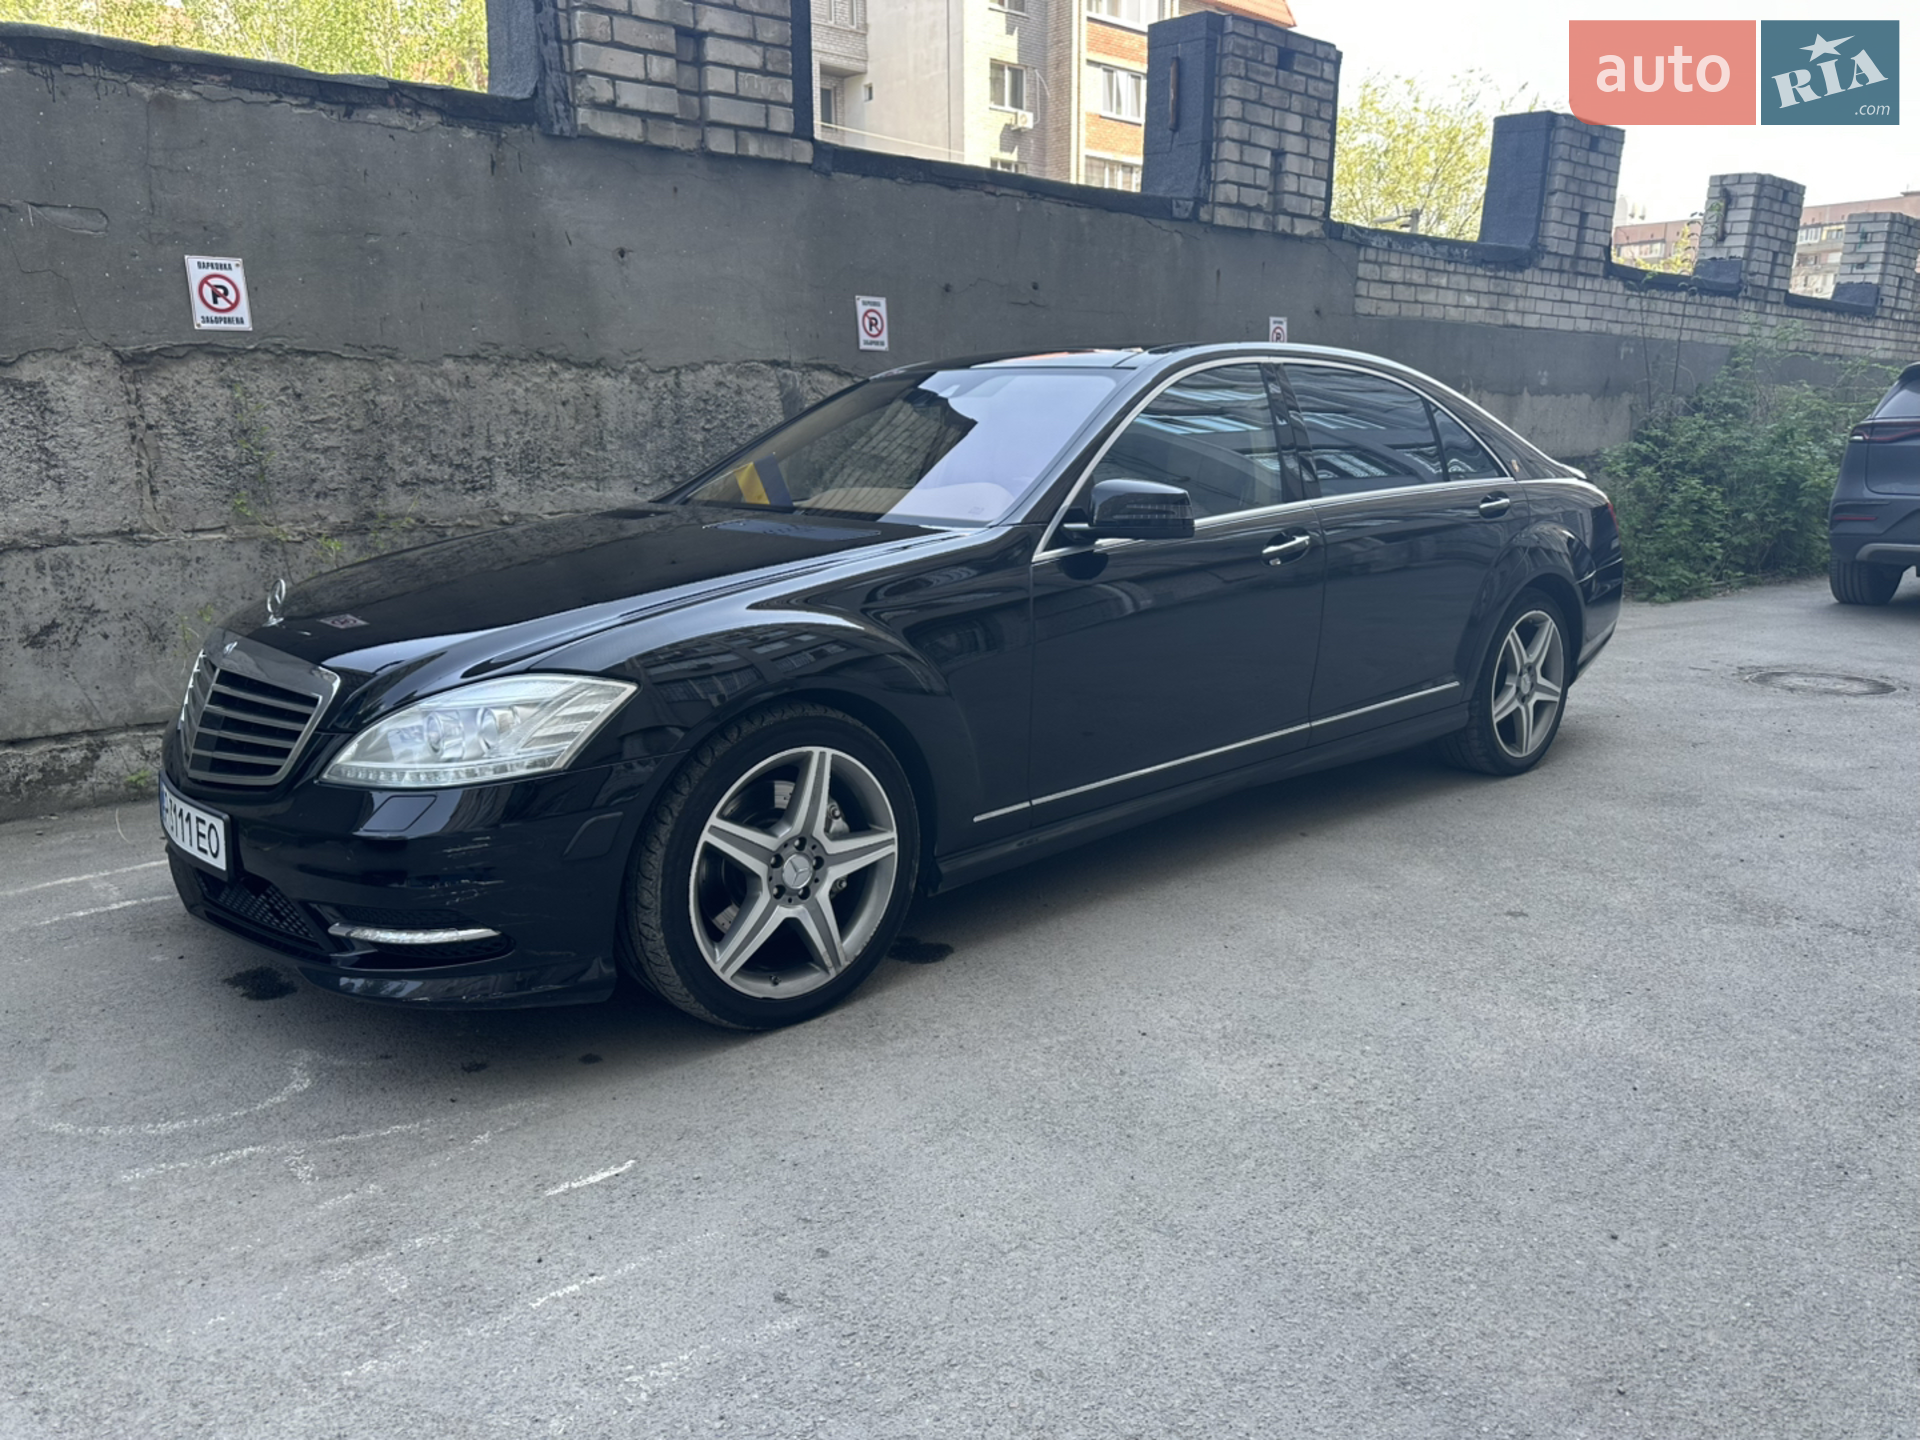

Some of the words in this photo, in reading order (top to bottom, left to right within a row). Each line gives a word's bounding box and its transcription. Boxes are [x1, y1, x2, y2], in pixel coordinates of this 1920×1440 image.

[197, 261, 233, 271] ПАРКОВКА
[211, 284, 229, 305] P
[200, 315, 245, 325] ЗАБОРОНЕНА
